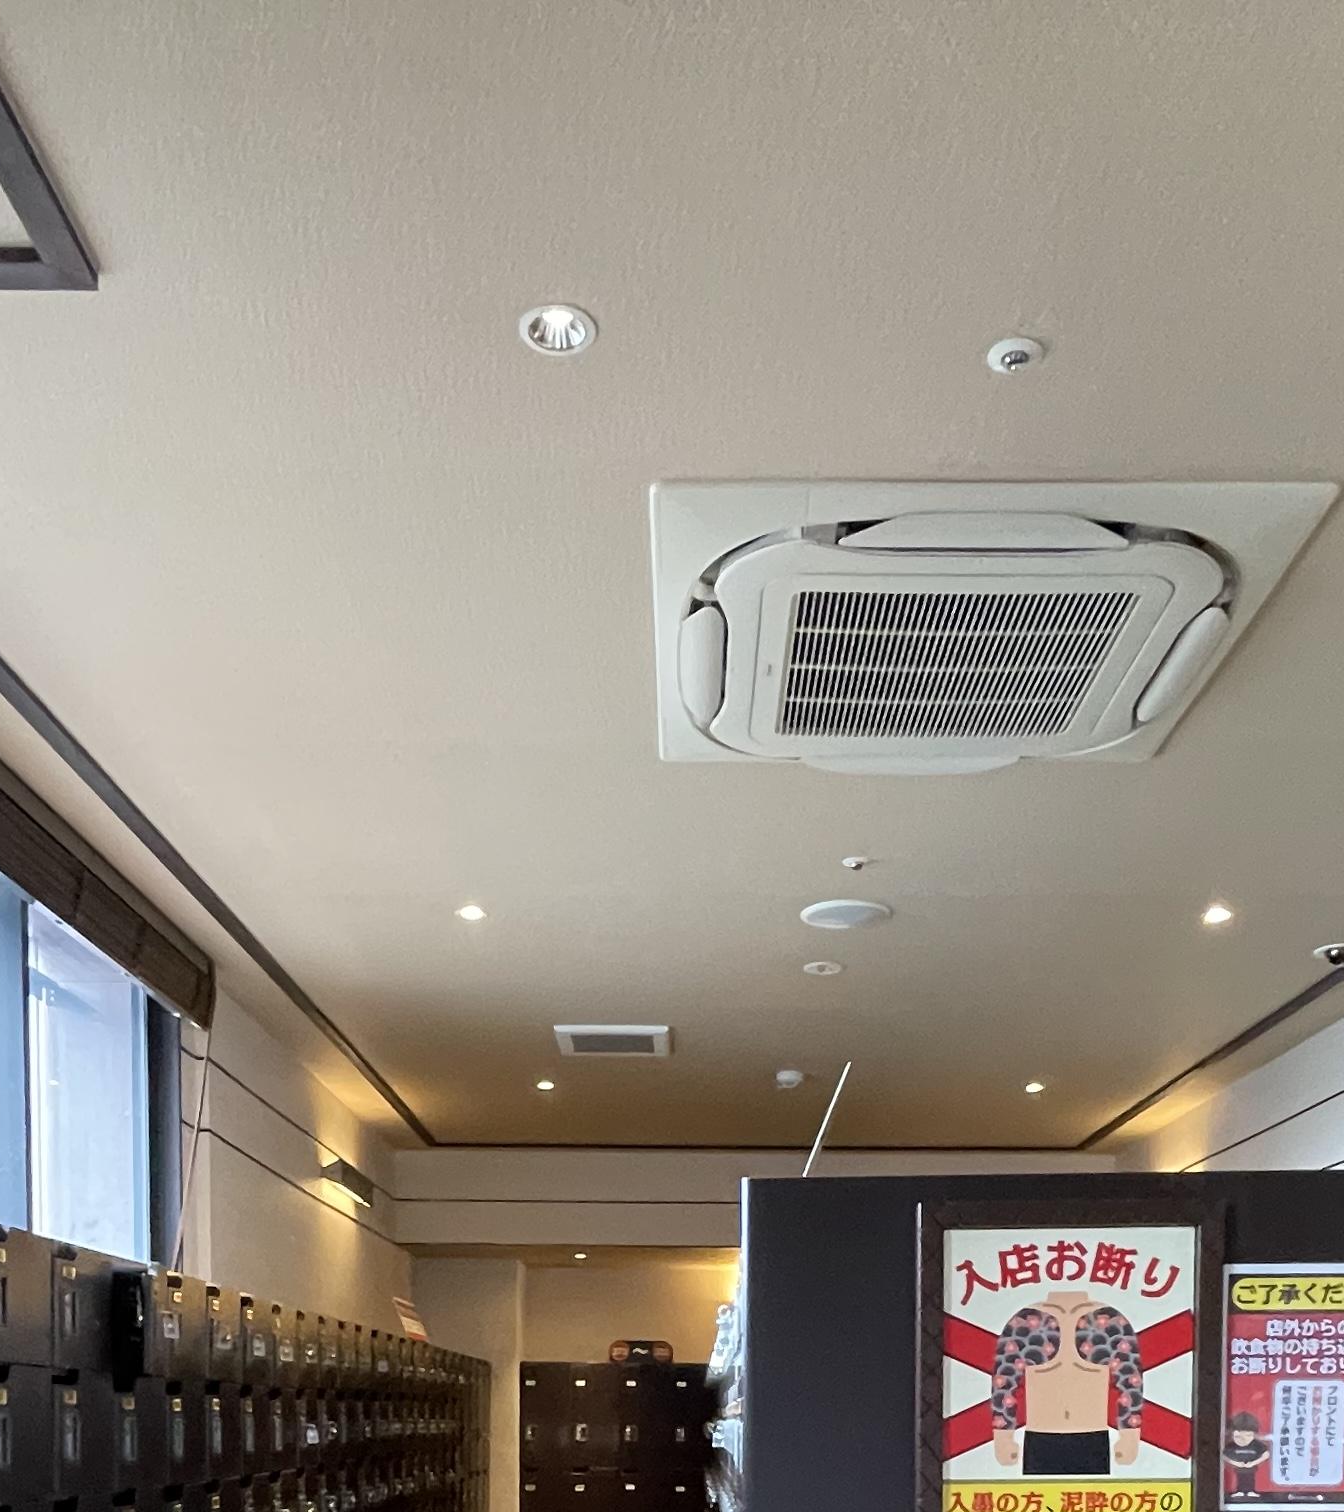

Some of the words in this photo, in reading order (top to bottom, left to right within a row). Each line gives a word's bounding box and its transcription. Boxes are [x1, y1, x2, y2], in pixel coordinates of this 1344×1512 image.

[956, 1239, 1181, 1305] 入店お断り
